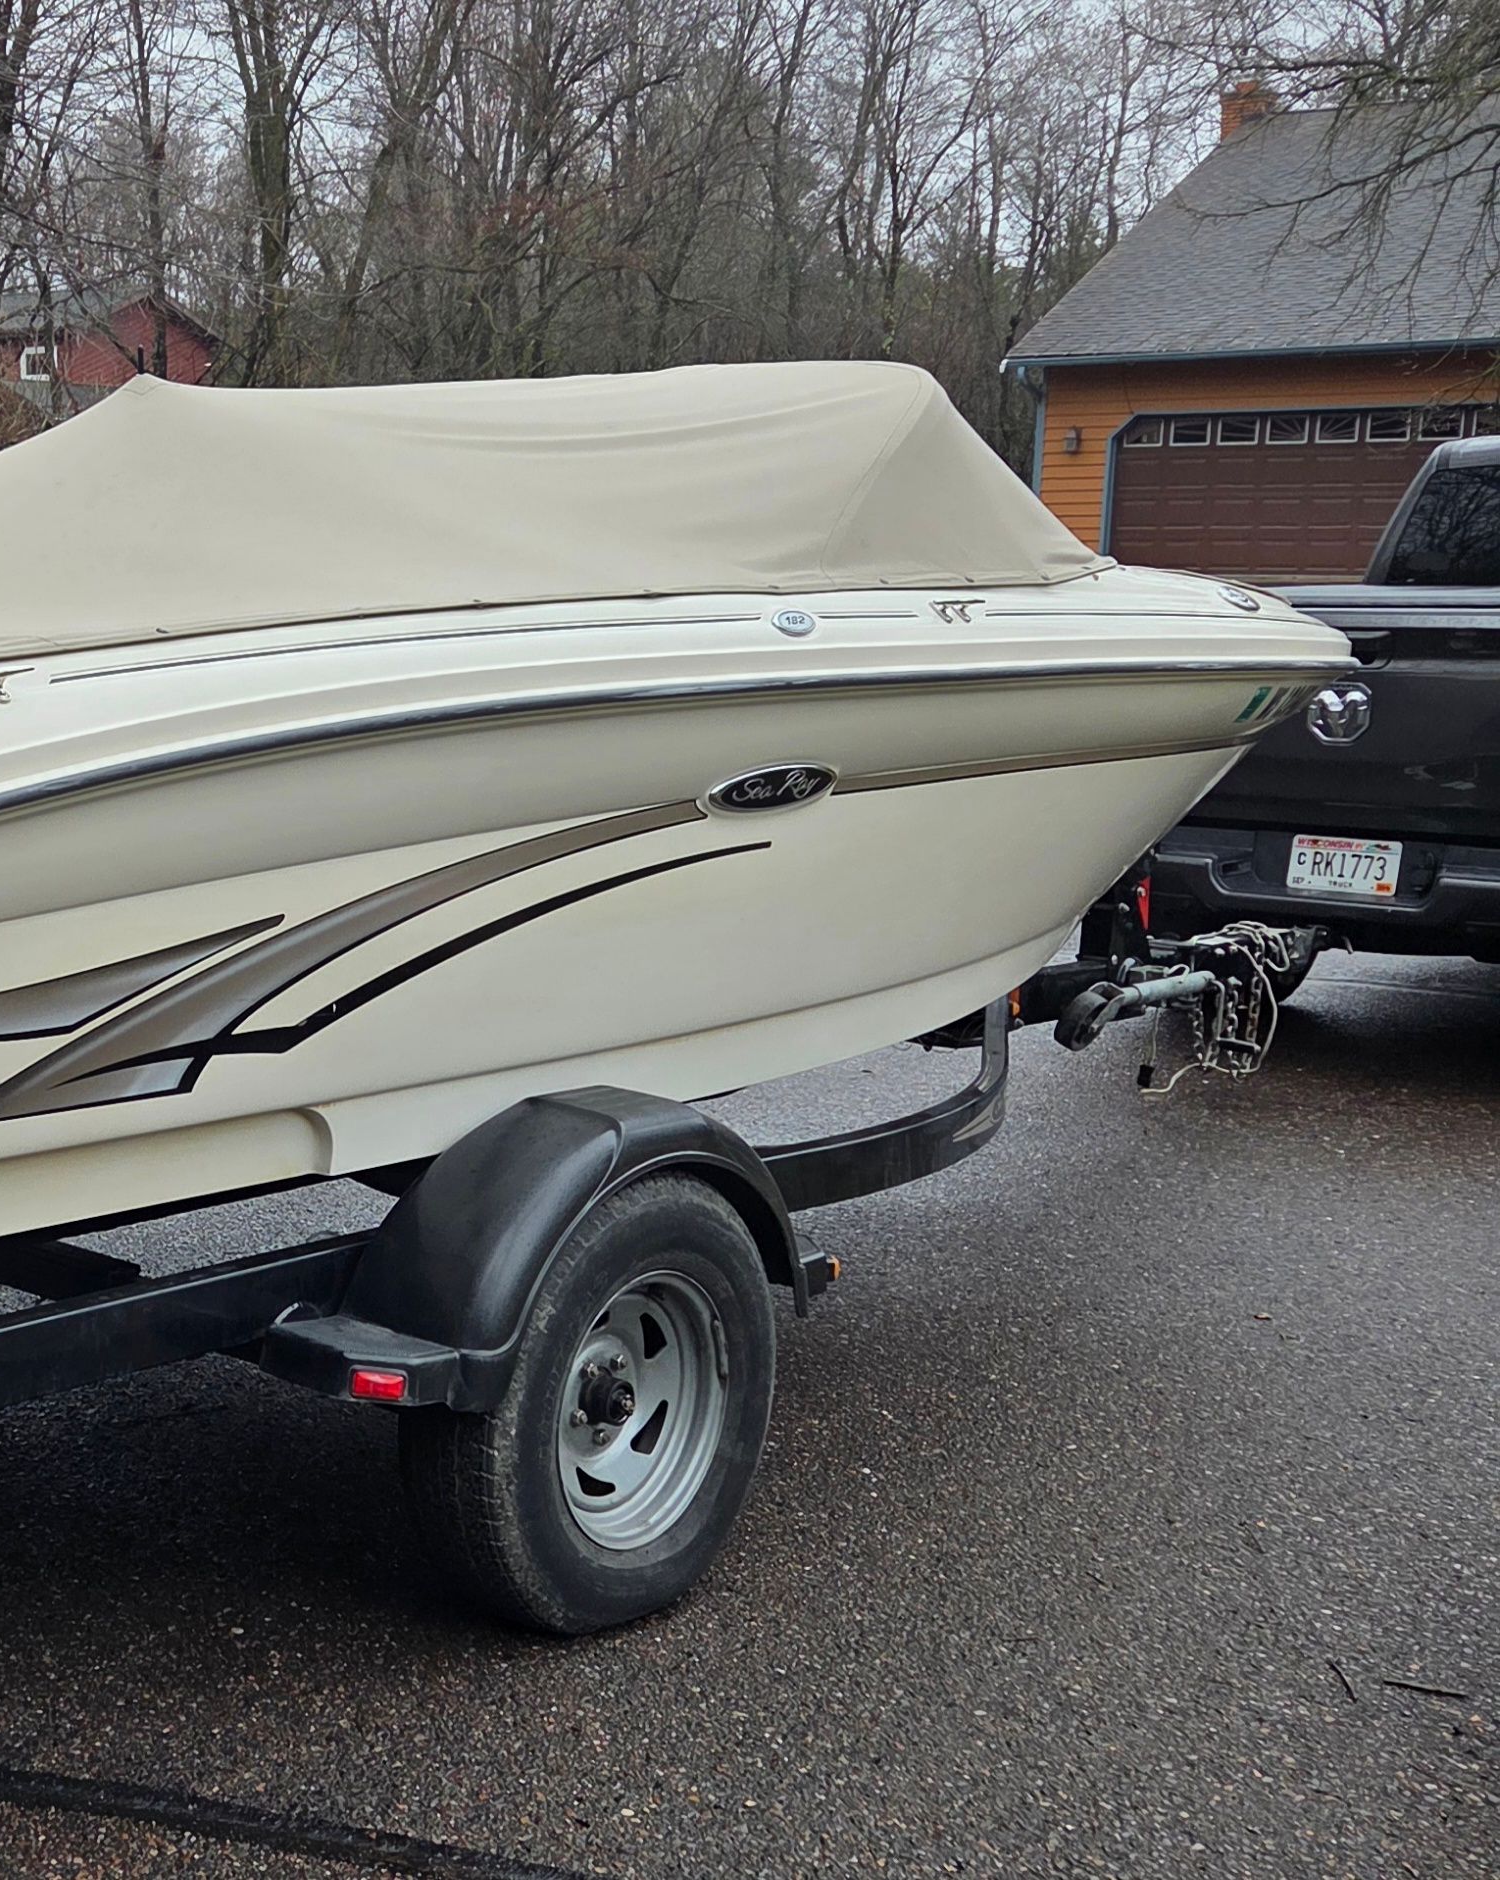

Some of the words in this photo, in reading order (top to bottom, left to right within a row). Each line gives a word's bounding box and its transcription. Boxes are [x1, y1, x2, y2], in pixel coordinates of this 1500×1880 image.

[785, 615, 806, 625] 182
[732, 778, 774, 802] Sea
[776, 769, 821, 799] Ray
[1297, 851, 1307, 866] C
[1310, 851, 1388, 881] RK1773
[1328, 880, 1353, 888] TRUCK
